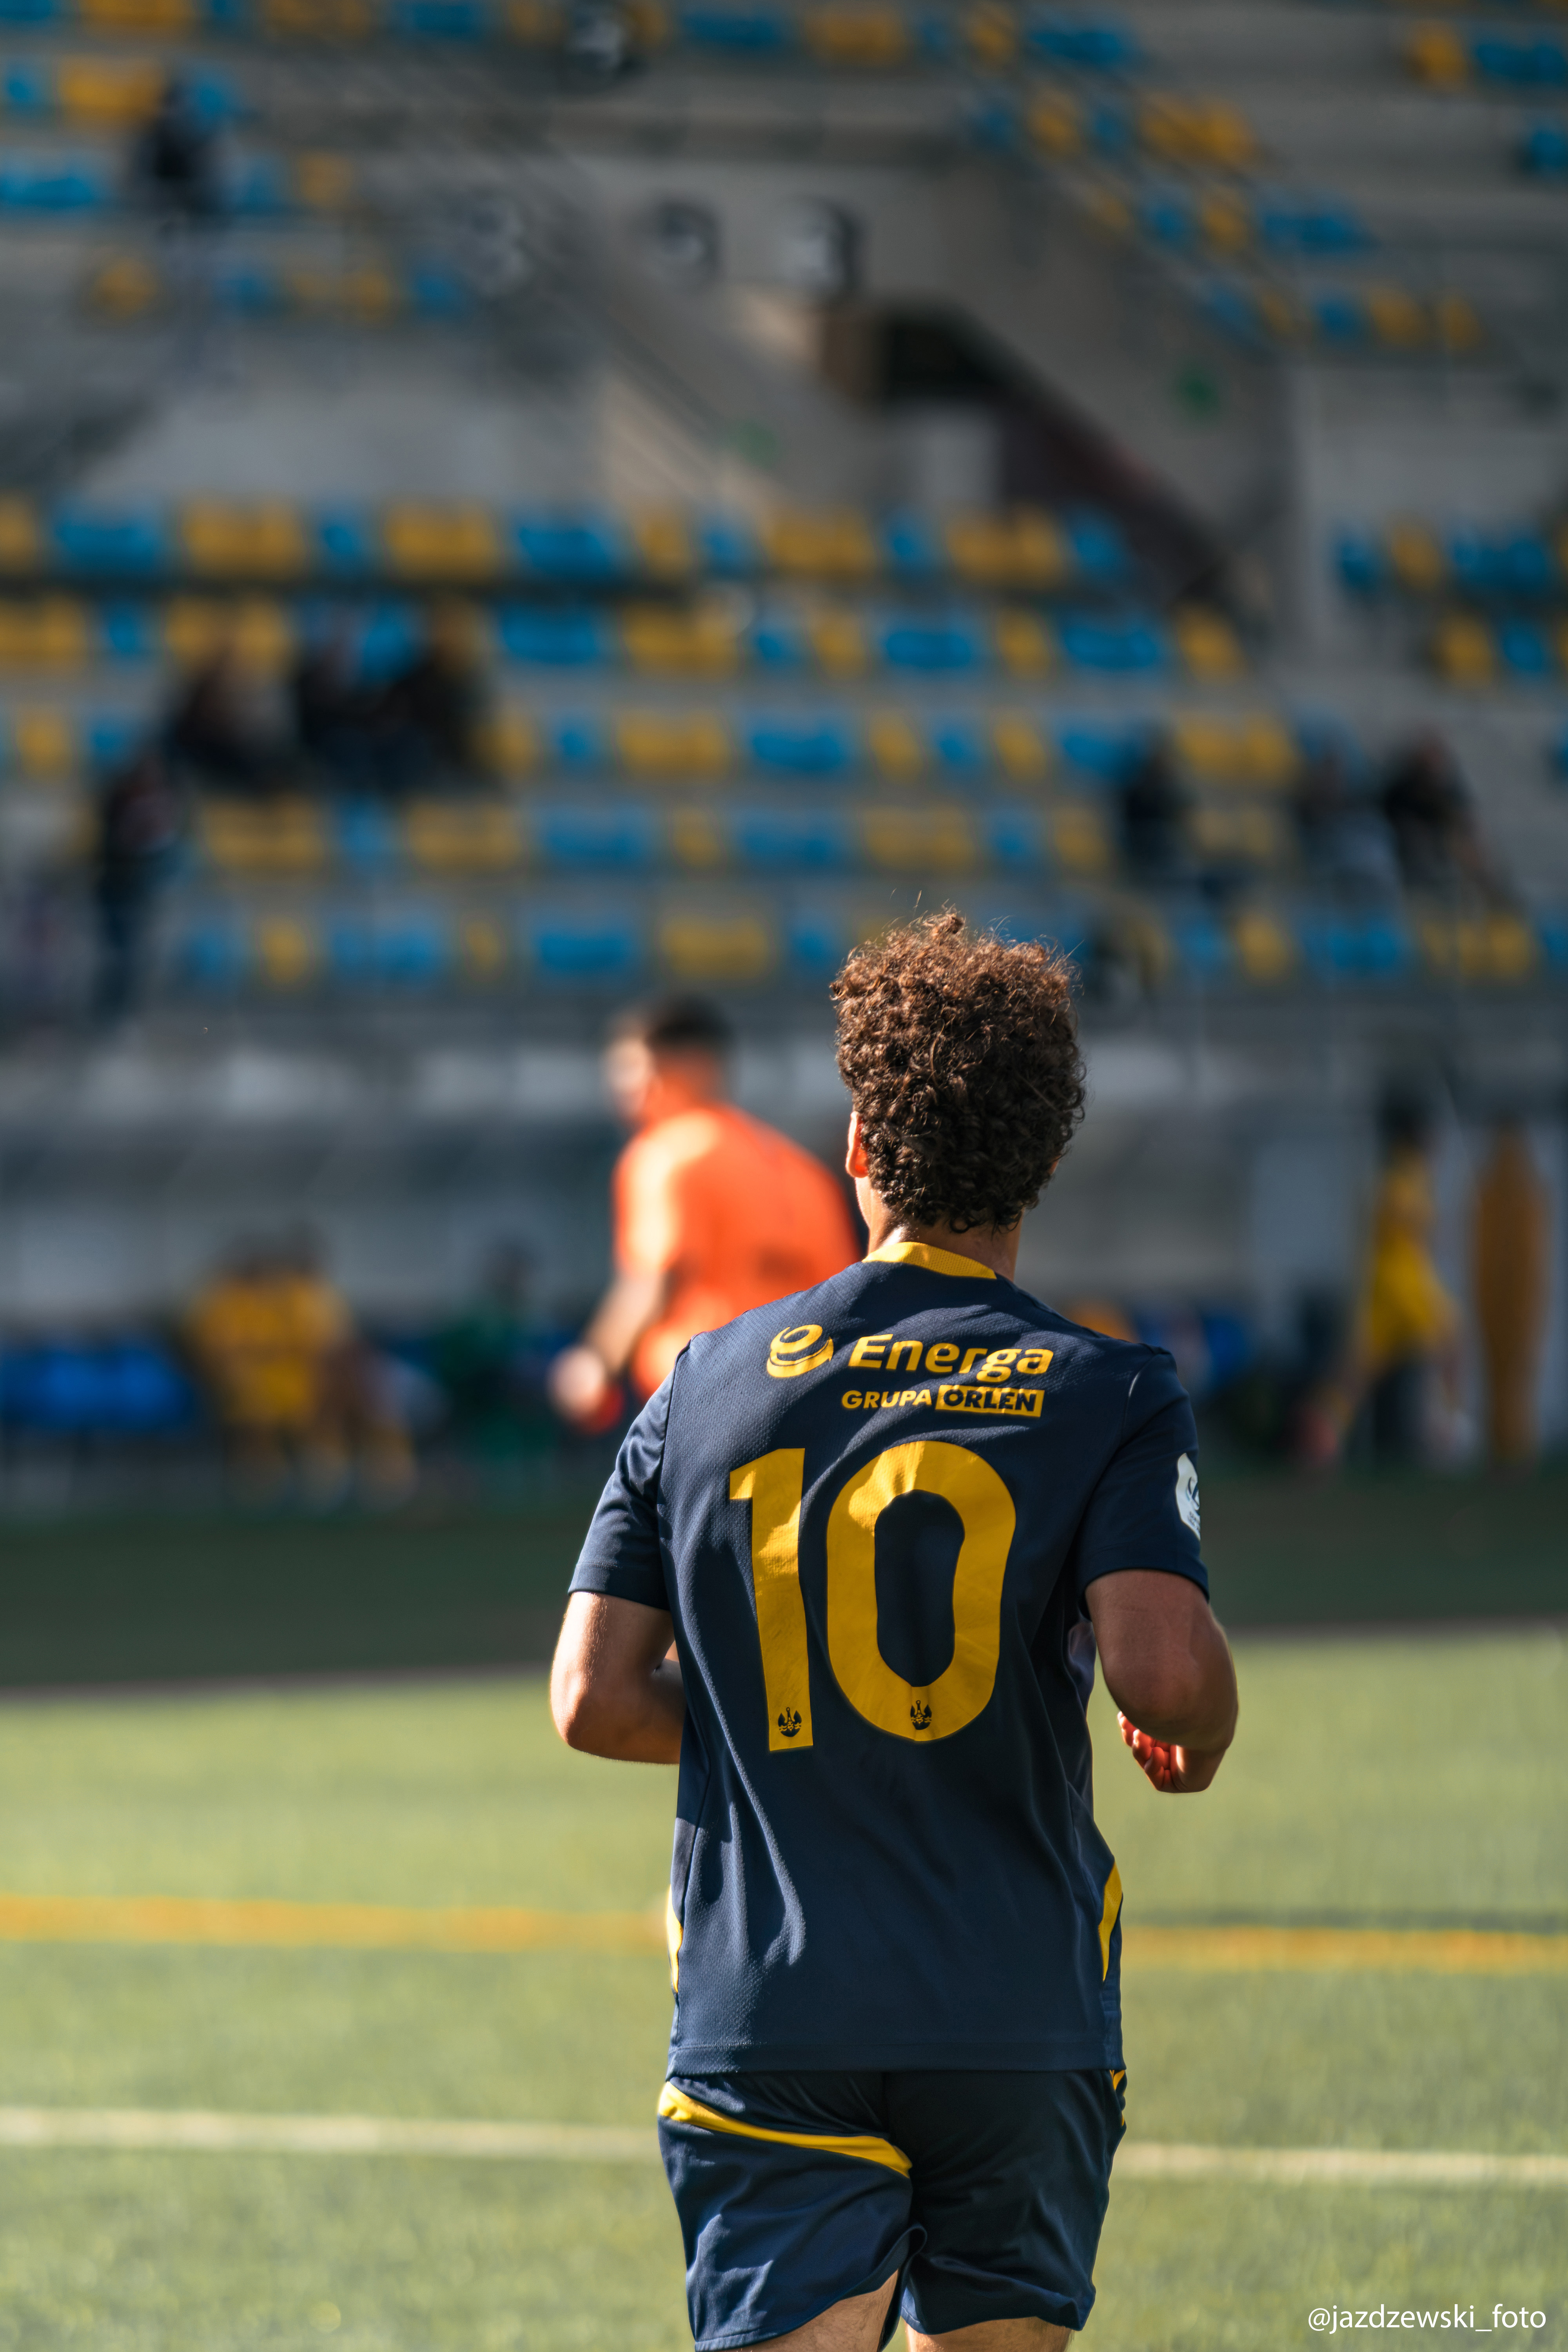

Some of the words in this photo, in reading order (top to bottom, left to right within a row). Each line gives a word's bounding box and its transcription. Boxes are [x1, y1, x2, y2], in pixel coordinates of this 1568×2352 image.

[848, 1334, 1054, 1382] Energa
[842, 1389, 931, 1408] GRUPA
[944, 1388, 1038, 1412] ORLEN
[730, 1440, 1016, 1751] 10
